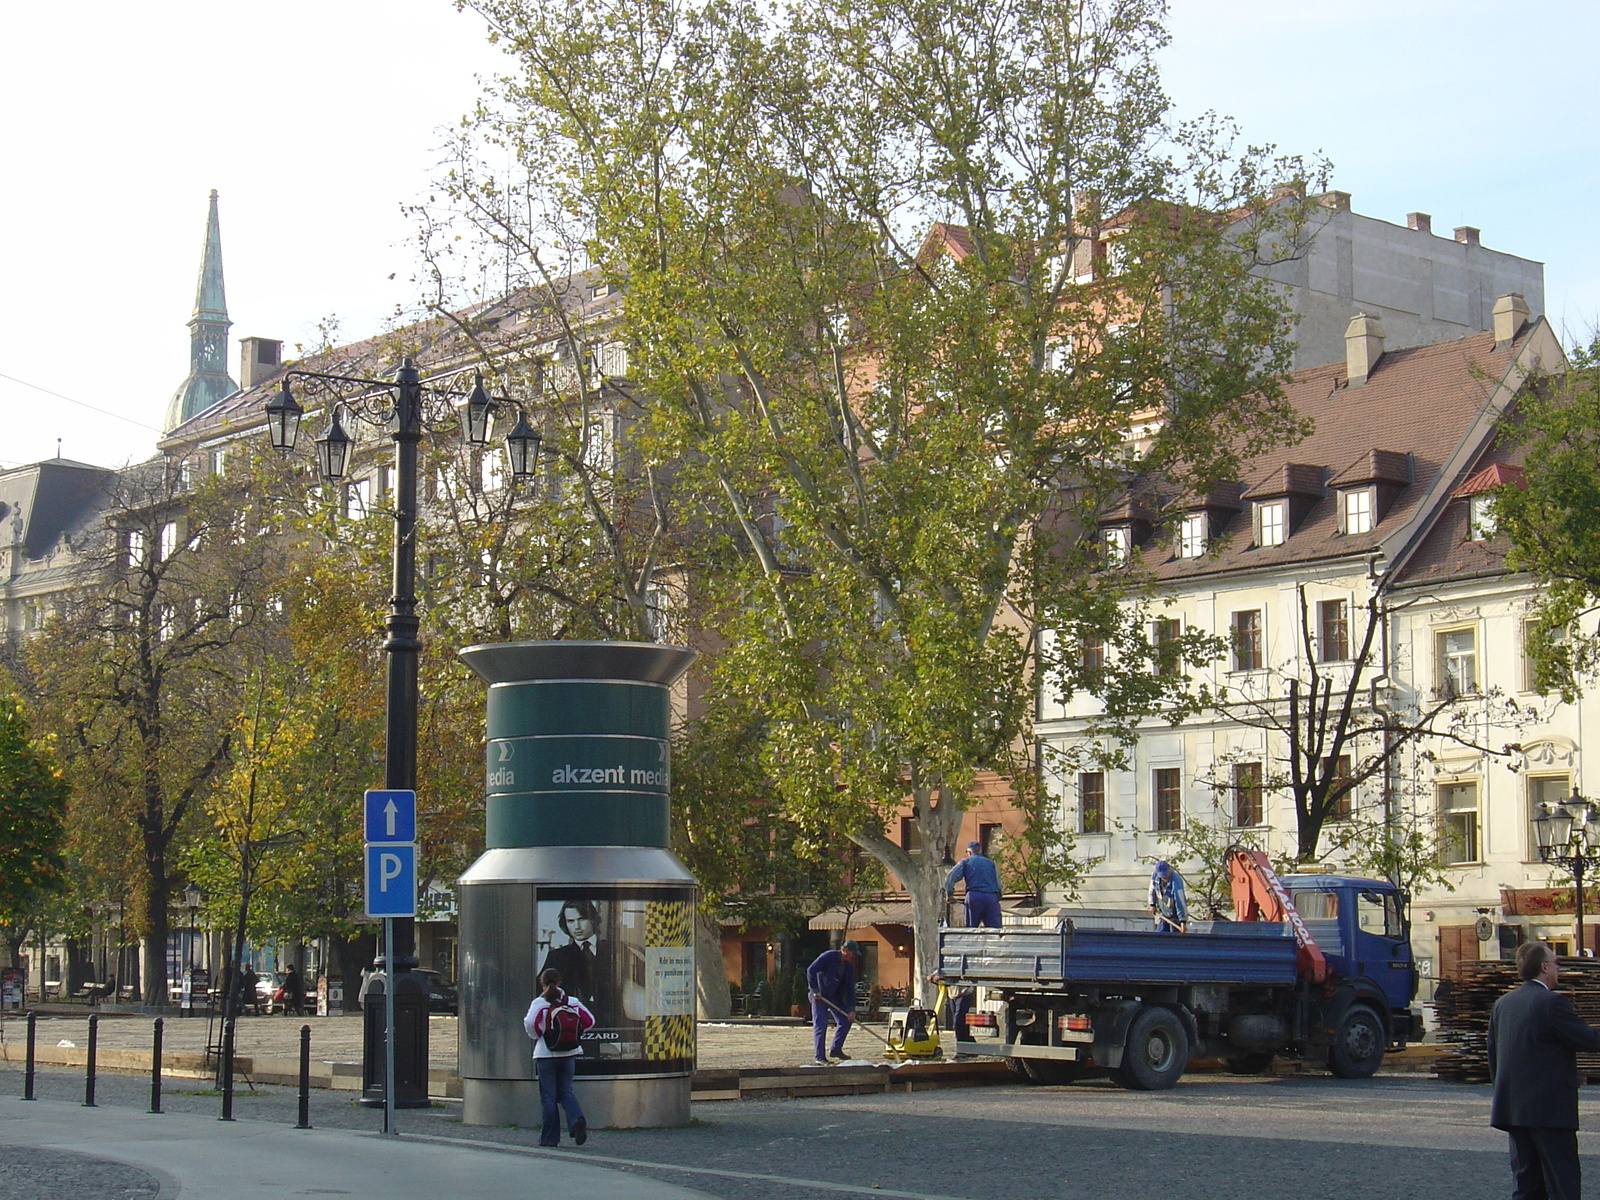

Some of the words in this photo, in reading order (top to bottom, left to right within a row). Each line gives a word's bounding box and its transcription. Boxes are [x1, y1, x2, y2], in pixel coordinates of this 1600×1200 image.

[552, 764, 625, 784] akzent
[630, 767, 669, 787] media
[380, 853, 402, 893] P
[1262, 866, 1295, 911] ATLAS
